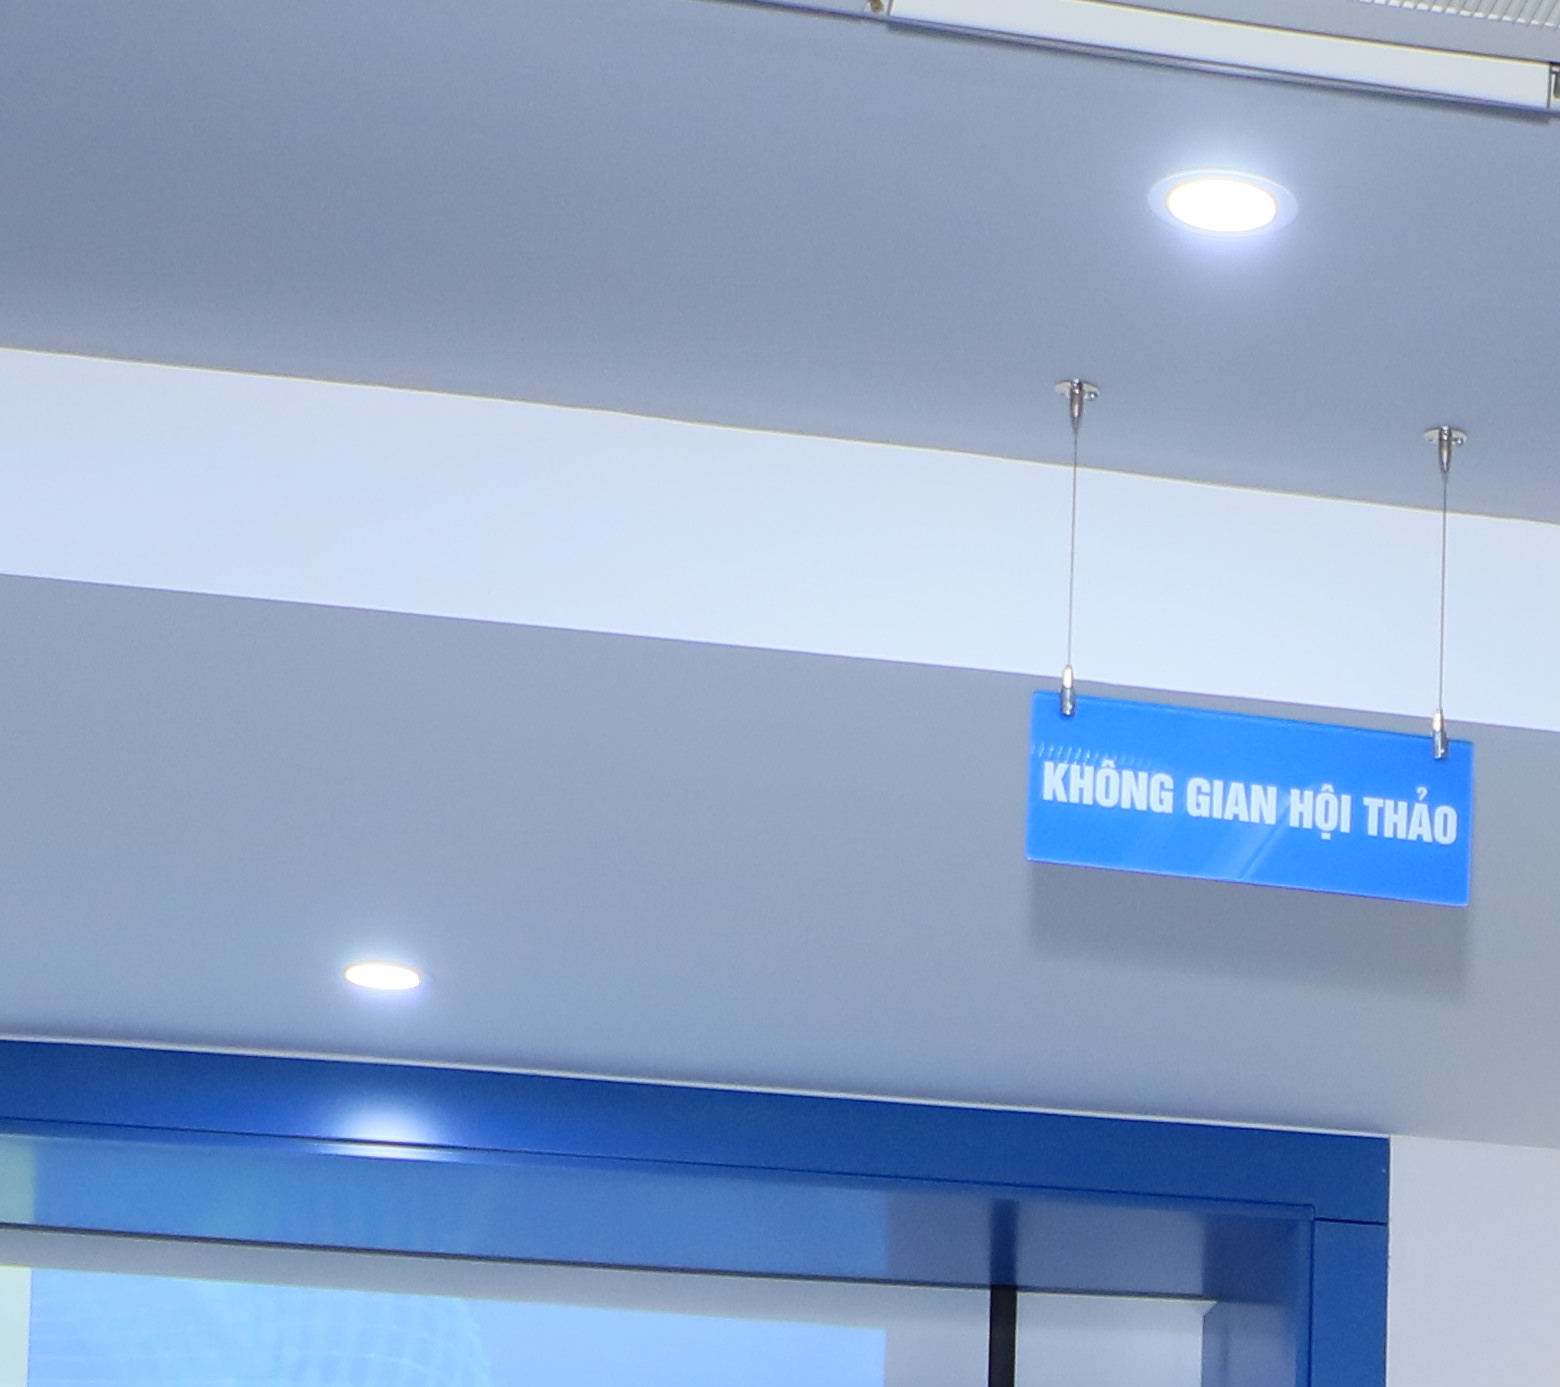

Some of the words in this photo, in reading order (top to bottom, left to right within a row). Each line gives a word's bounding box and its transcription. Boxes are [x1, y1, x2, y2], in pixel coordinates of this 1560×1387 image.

[1042, 758, 1174, 814] KHÔNG
[1185, 776, 1278, 825] GIAN
[1289, 783, 1352, 840] HỘI
[1362, 786, 1458, 845] THẢO
